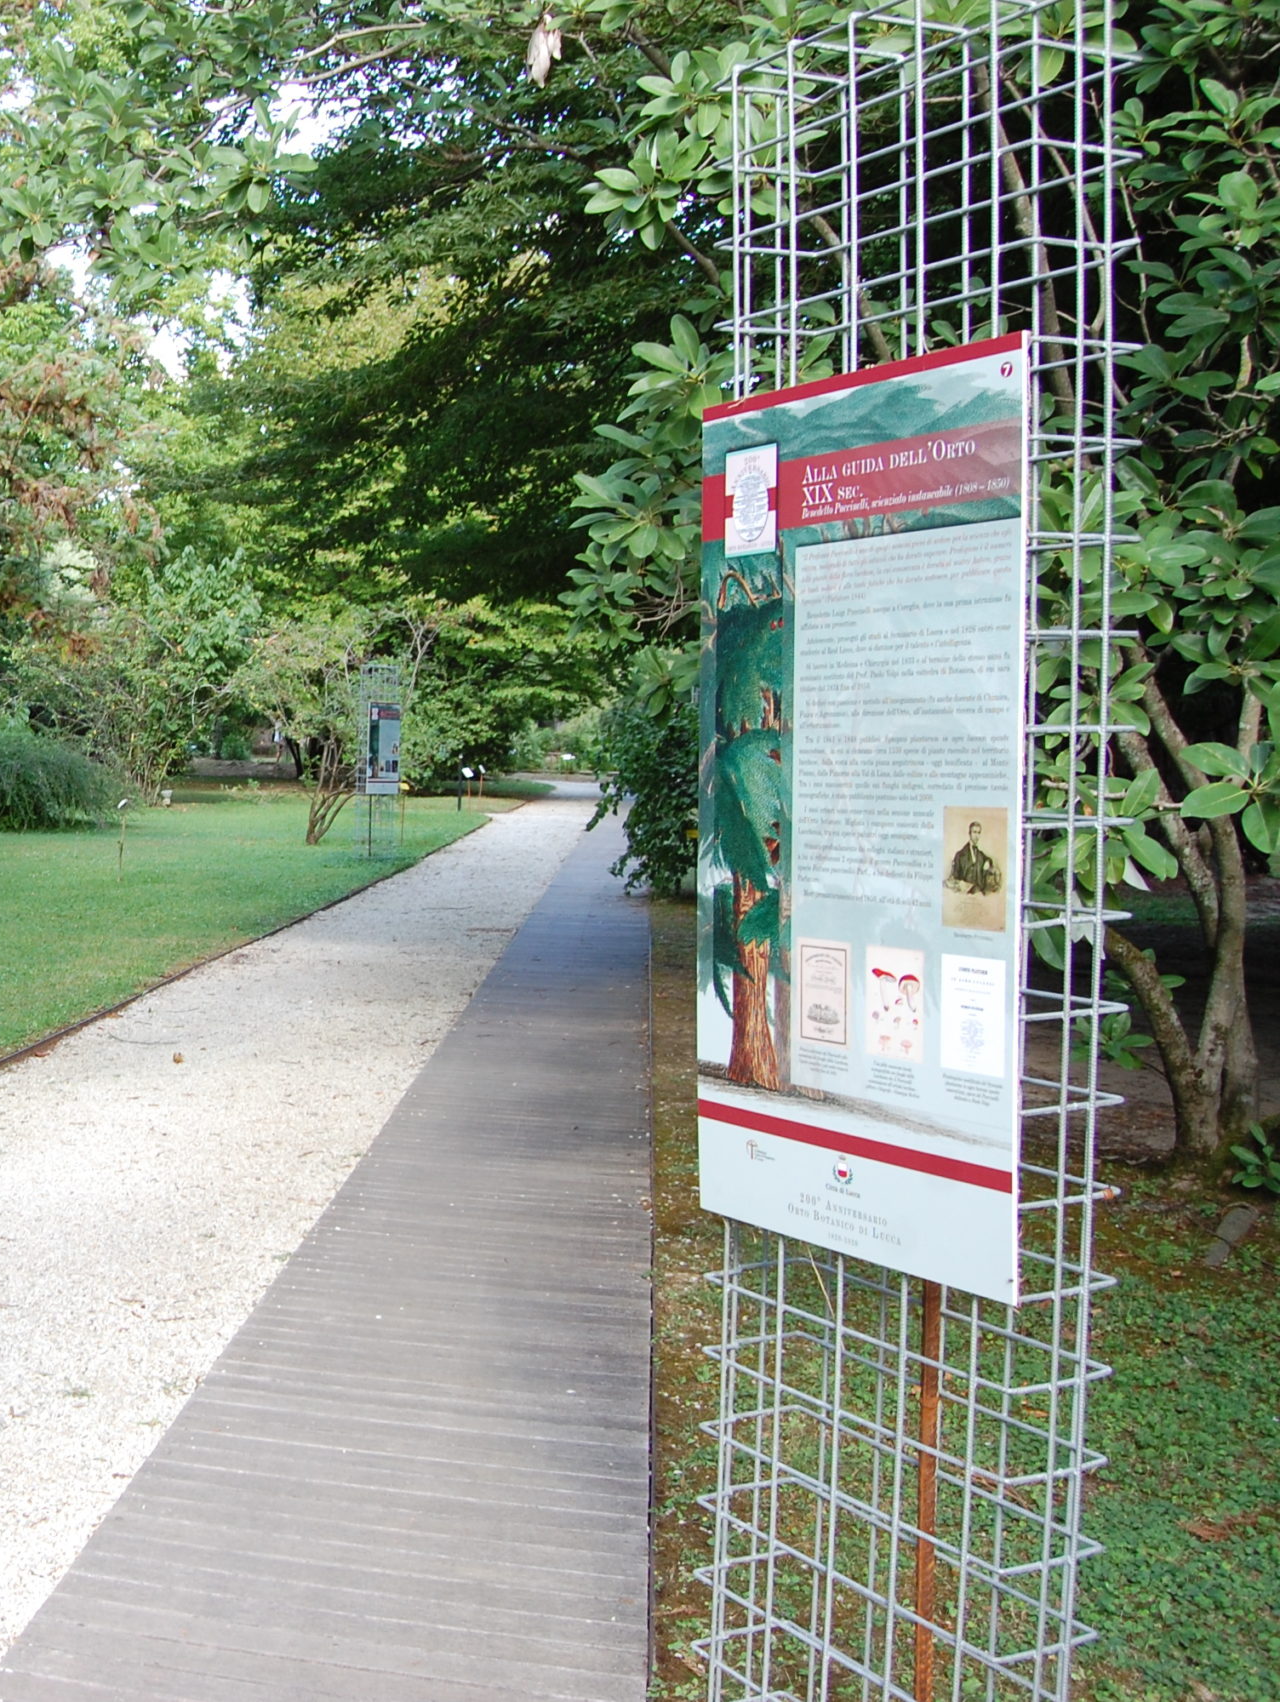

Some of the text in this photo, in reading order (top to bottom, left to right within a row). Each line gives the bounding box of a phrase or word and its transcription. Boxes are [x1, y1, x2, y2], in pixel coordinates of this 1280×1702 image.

[802, 482, 832, 506] XIX
[802, 504, 833, 519] Benedetto
[834, 498, 869, 517] Puccinelli,
[871, 493, 906, 508] scienziato
[908, 485, 951, 502] instancabile
